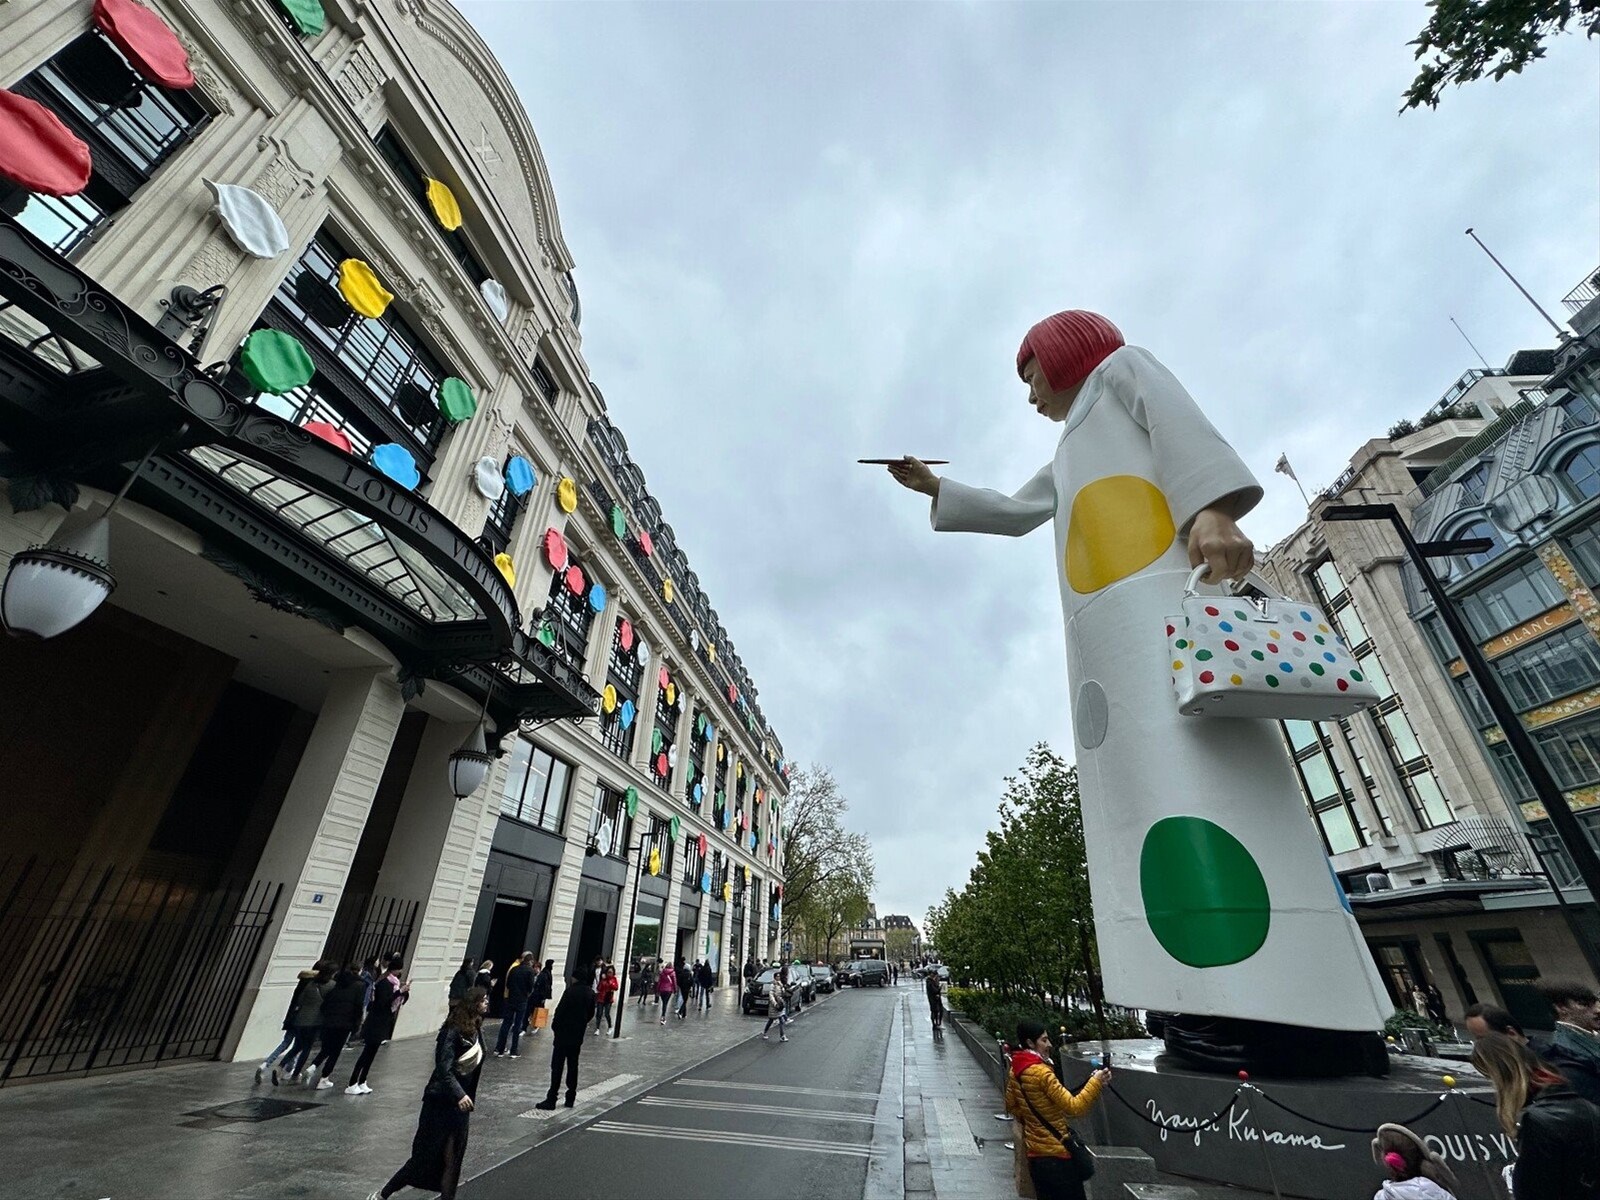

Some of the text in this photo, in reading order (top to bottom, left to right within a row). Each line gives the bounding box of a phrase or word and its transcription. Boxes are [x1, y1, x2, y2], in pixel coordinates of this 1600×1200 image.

[338, 462, 508, 614] LOUIS VUITTON
[1502, 615, 1553, 646] BLANC
